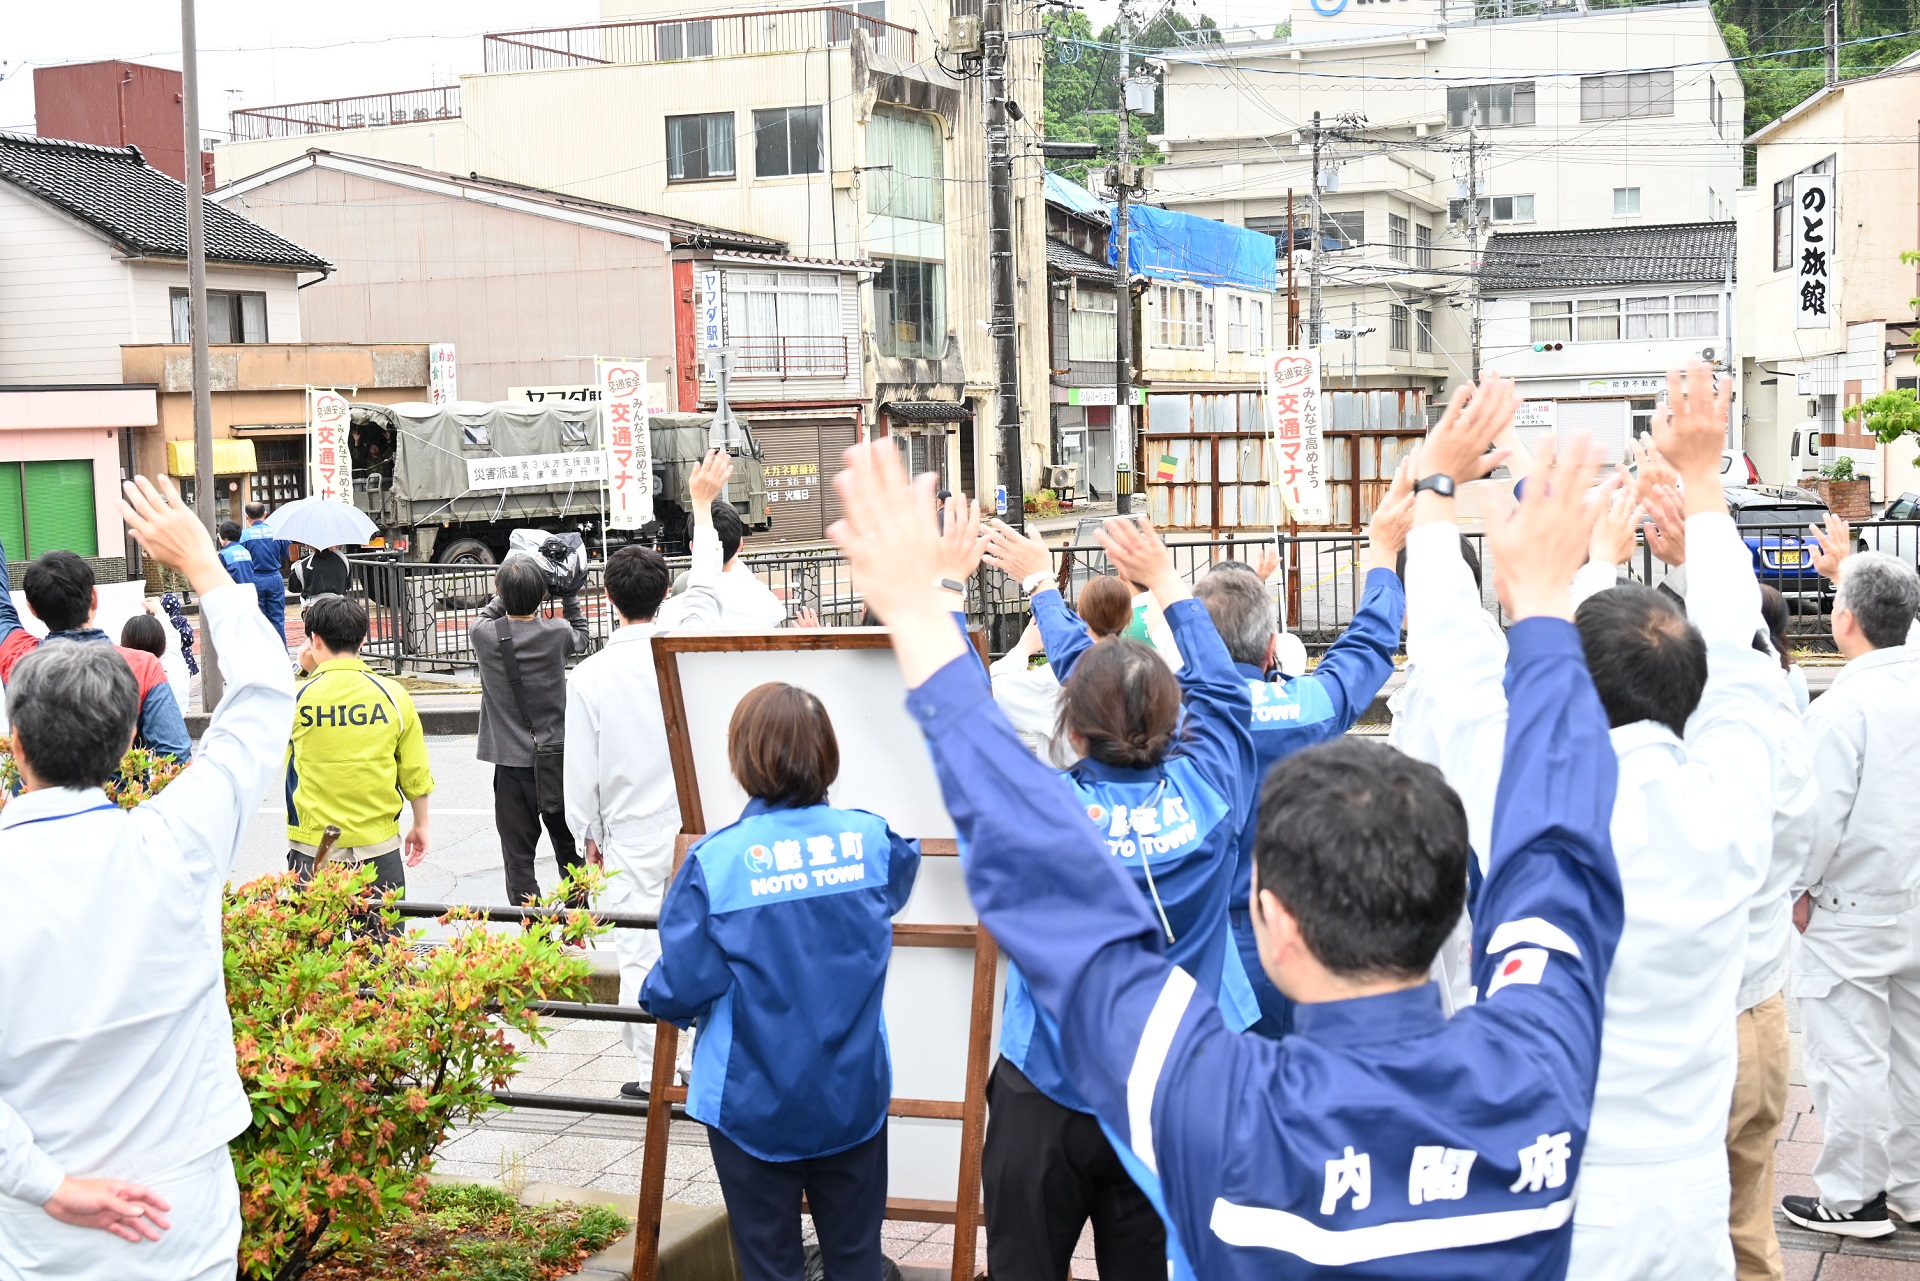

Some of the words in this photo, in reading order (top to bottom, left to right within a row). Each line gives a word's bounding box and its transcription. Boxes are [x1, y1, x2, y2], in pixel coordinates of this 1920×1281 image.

[1801, 187, 1827, 316] のと旅館
[705, 274, 718, 378] ヤマダ駅
[608, 377, 641, 392] 交通安全
[1274, 364, 1313, 382] 交通安全
[1612, 380, 1658, 388] 能登不動産
[610, 403, 634, 510] 交通マナー
[632, 398, 648, 494] みんなで高めよう
[1276, 393, 1304, 503] 交通マナー
[1302, 387, 1319, 489] みんなで高めよう
[473, 465, 519, 481] 災害派遣
[299, 703, 389, 727] SHIGA
[772, 832, 864, 871] 能登町
[1104, 839, 1136, 857] TO
[1141, 819, 1197, 855] TOWN
[750, 872, 808, 896] NOTO
[811, 862, 864, 887] TOWN
[1320, 1131, 1571, 1215] 内閣府
